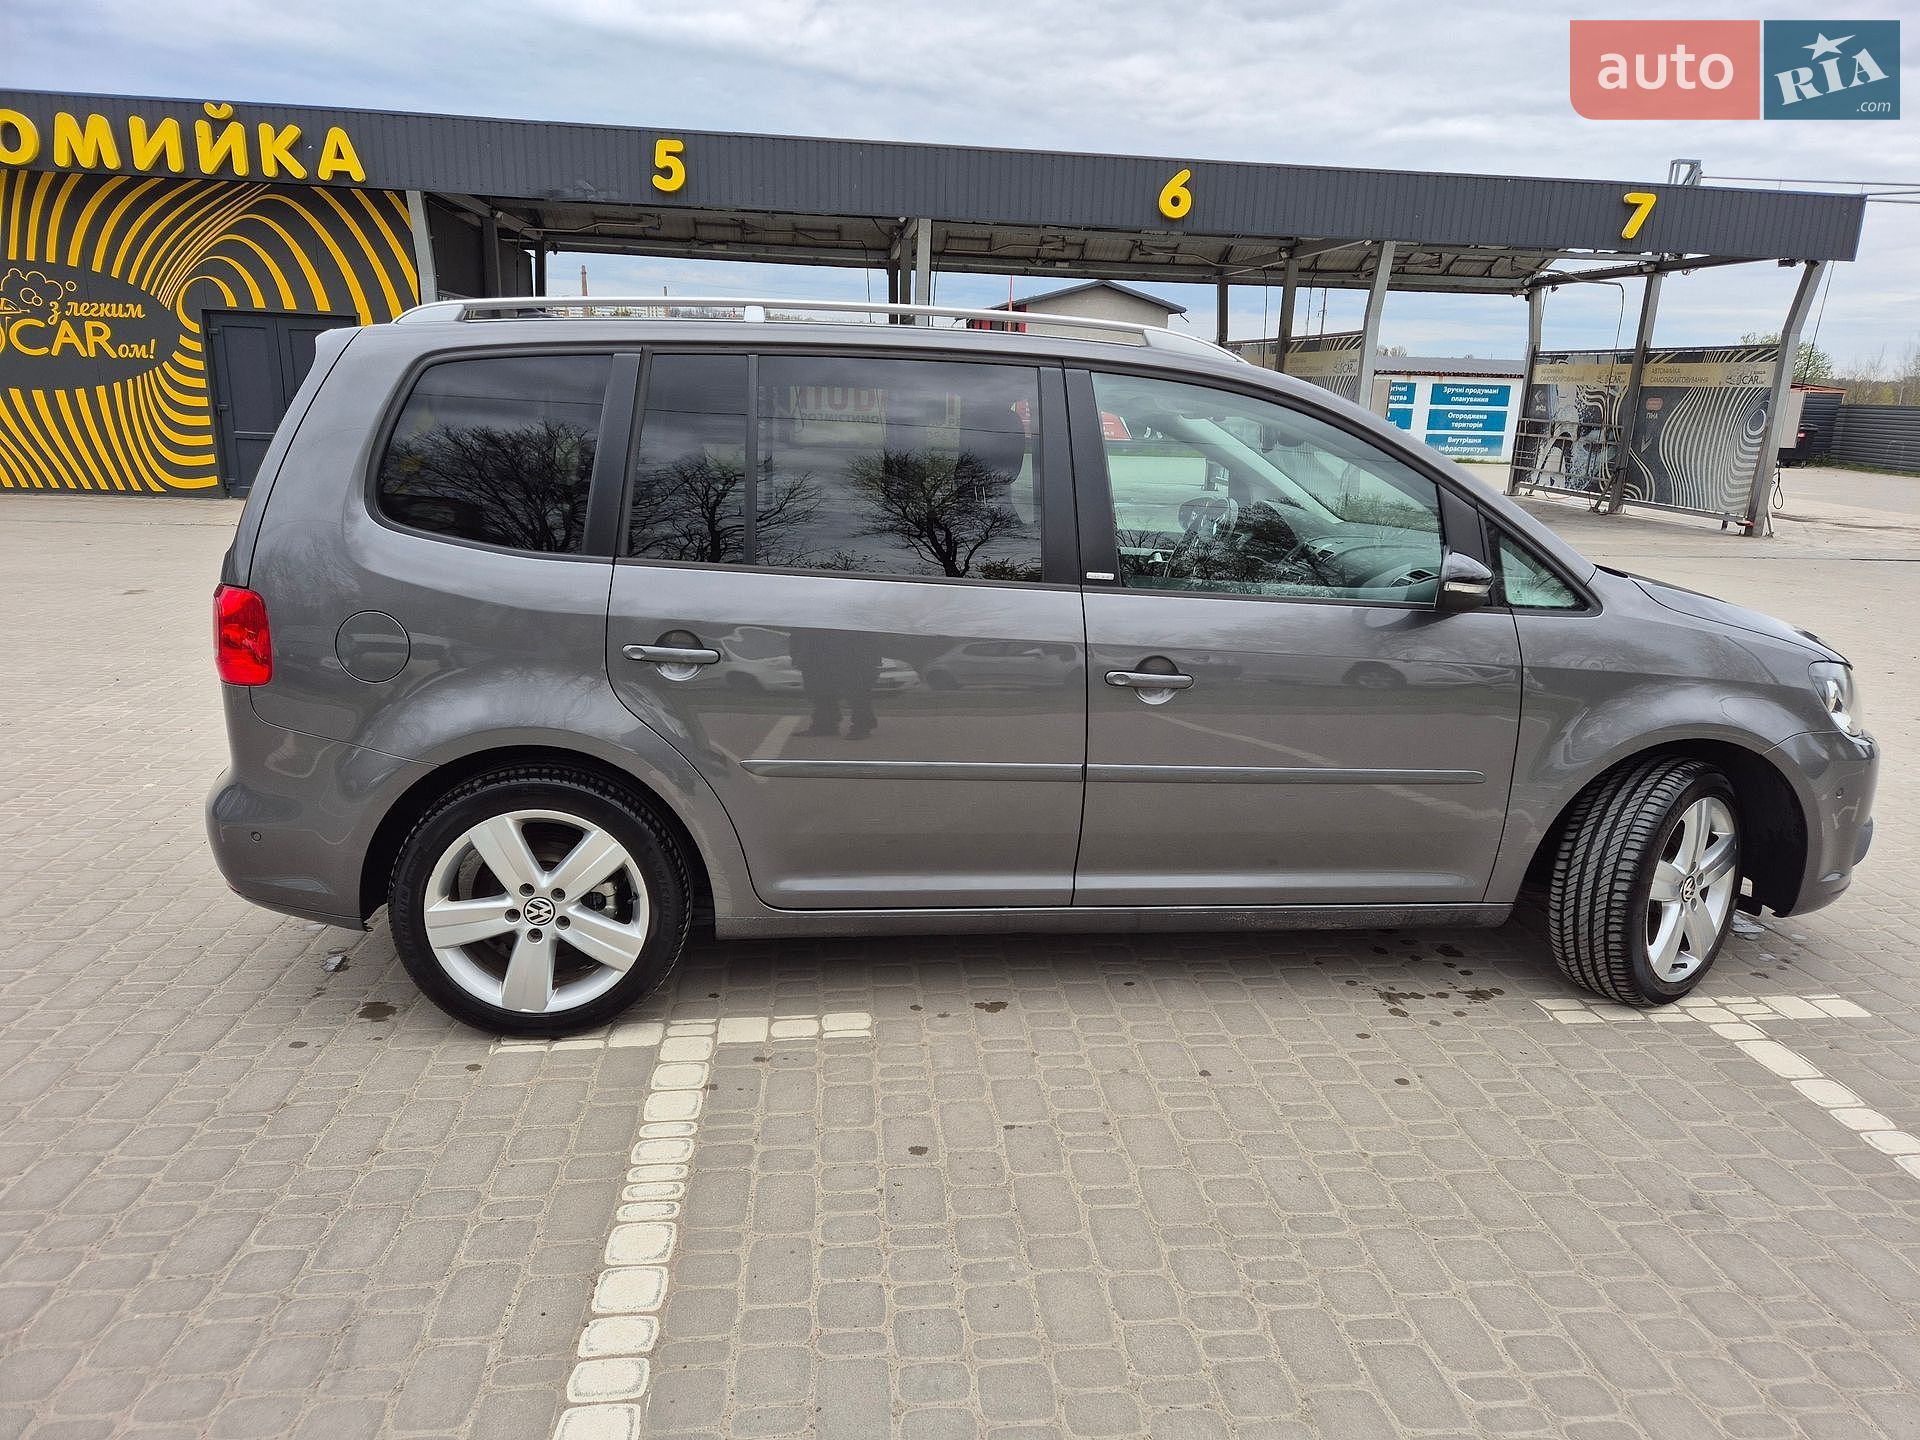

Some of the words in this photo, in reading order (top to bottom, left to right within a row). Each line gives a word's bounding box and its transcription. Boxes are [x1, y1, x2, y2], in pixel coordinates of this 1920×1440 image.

[651, 138, 687, 193] 5
[1158, 168, 1194, 220] 6
[1621, 192, 1658, 240] 7
[65, 301, 146, 319] легким
[1443, 386, 1464, 394] Зручні
[1465, 387, 1499, 395] продумані
[1447, 412, 1487, 420] Огороджена
[1451, 421, 1483, 429] територія
